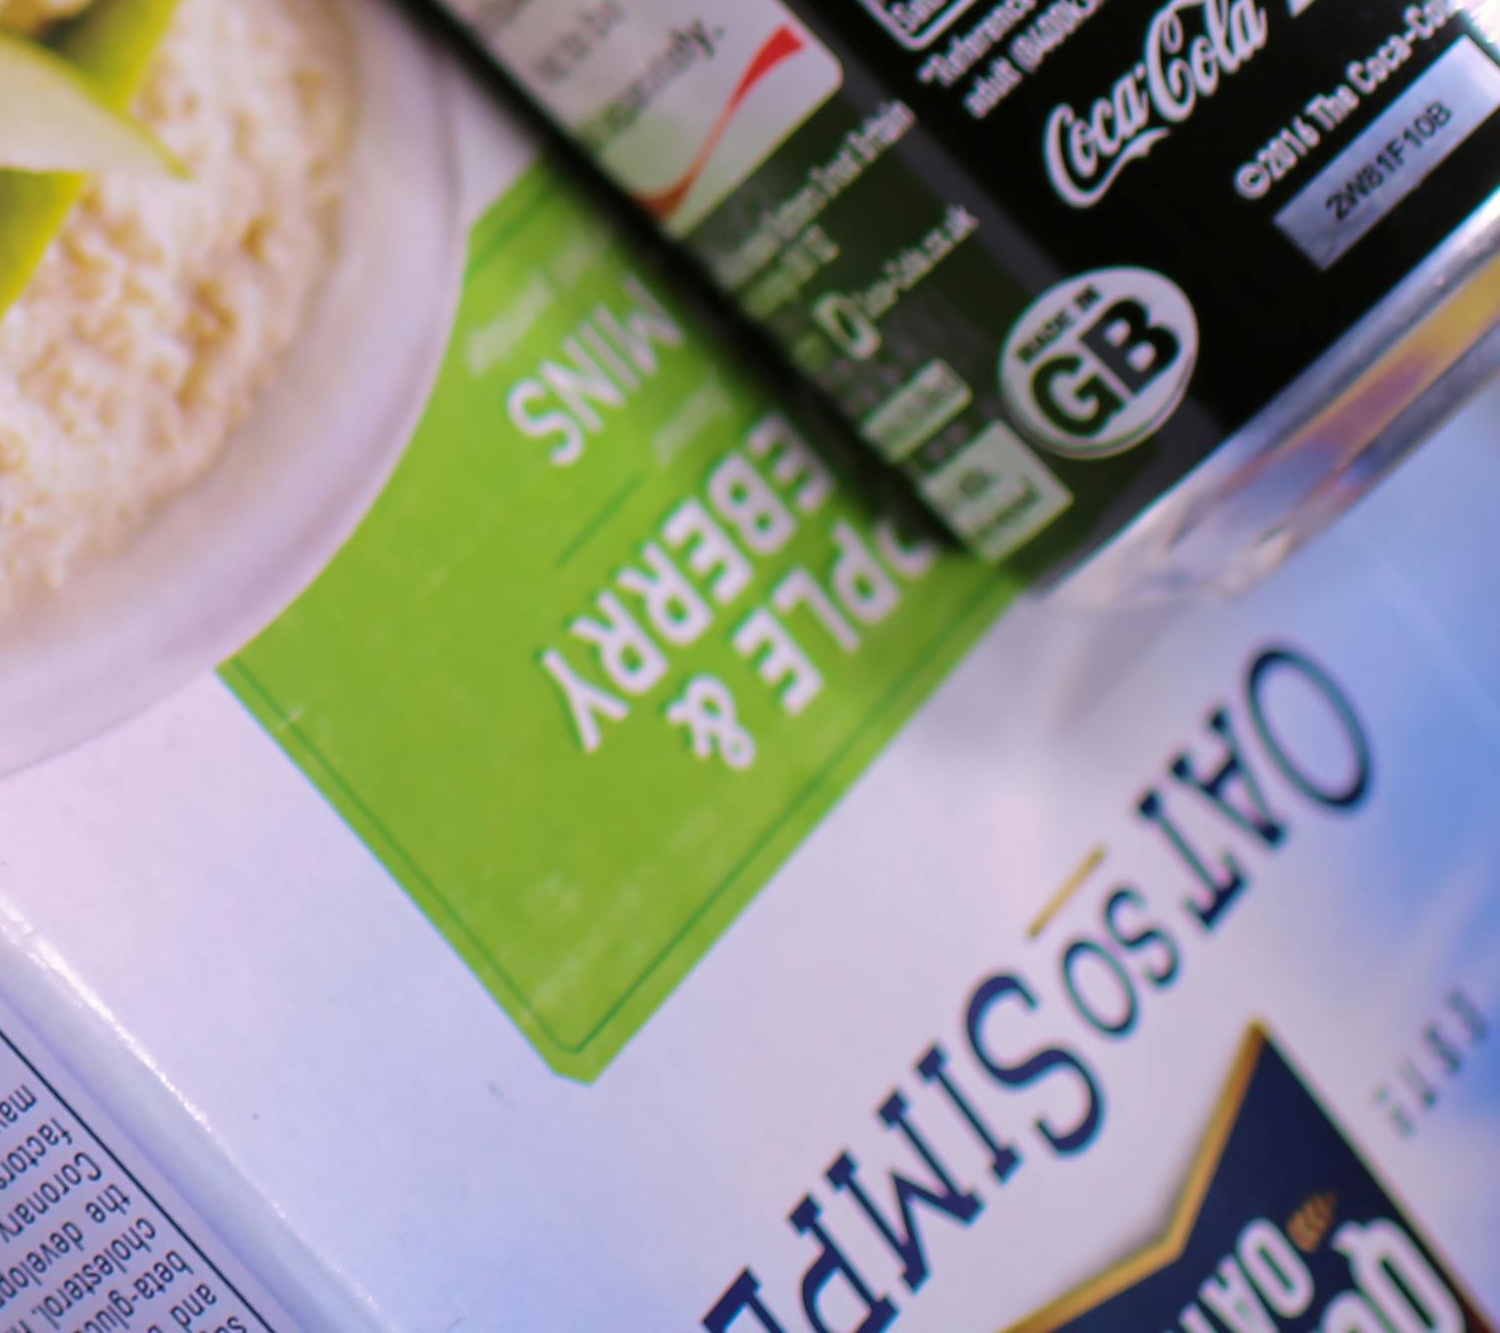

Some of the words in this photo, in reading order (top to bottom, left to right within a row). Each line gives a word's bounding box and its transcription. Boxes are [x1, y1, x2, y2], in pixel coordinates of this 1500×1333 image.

[1304, 81, 1360, 132] The
[503, 269, 695, 466] MINS
[1027, 294, 1182, 442] GB
[537, 406, 848, 748] EBERRY
[730, 485, 943, 713] PPLE
[663, 671, 765, 775] &
[84, 1182, 132, 1227] the
[700, 969, 1117, 1333] SIMPL
[31, 1217, 158, 1330] cholesterol.
[74, 1248, 191, 1333] beta-gluc
[168, 1282, 218, 1332] and
